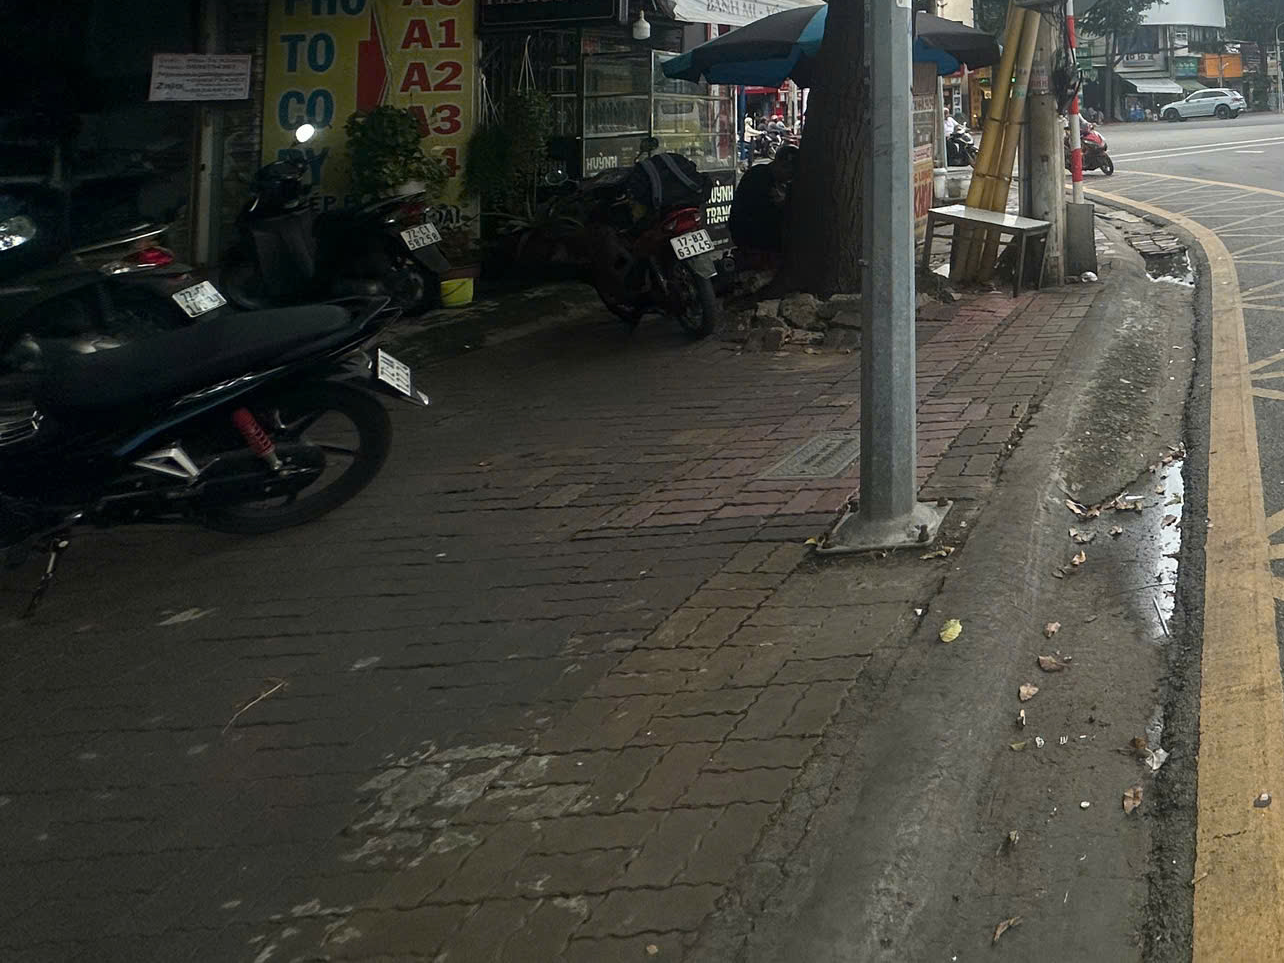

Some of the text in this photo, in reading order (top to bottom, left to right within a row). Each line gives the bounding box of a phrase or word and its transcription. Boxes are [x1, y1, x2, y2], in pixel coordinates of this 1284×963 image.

[400, 18, 462, 50] A1
[279, 32, 335, 73] TO
[400, 61, 463, 93] A2
[277, 88, 334, 131] CO
[586, 151, 618, 171] HUỲNH
[706, 178, 734, 205] UỲNH
[677, 231, 704, 247] 17-B3
[677, 240, 712, 258] 631.45
